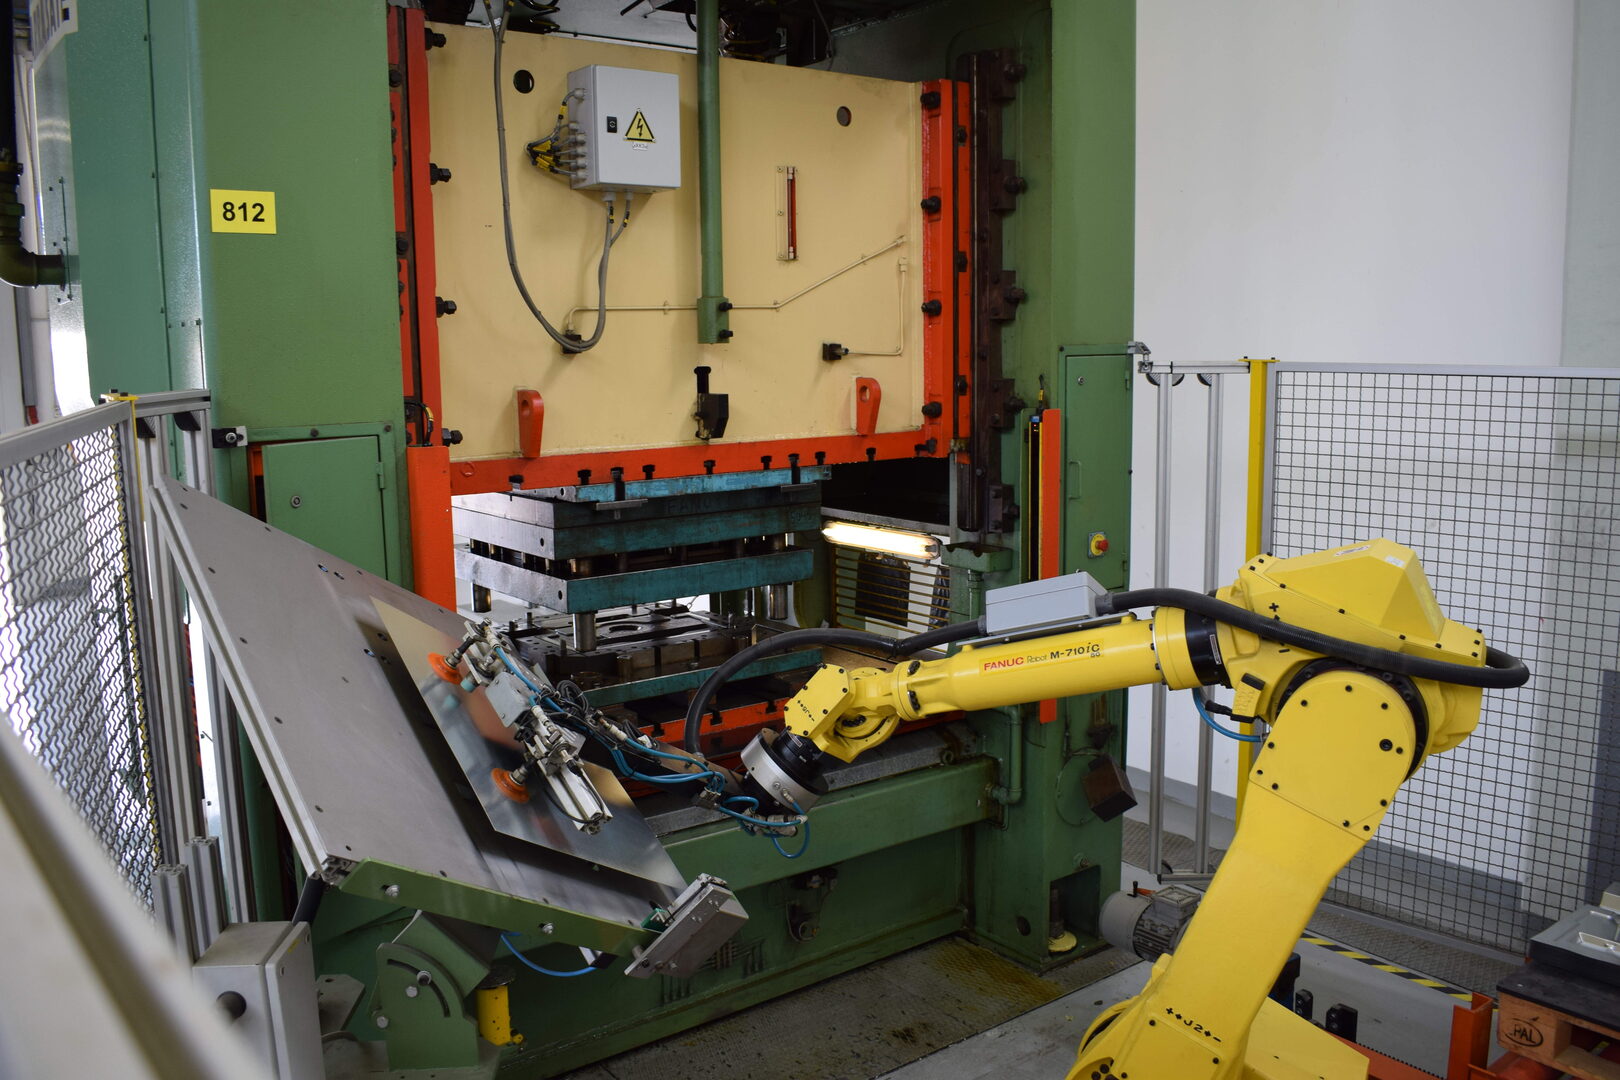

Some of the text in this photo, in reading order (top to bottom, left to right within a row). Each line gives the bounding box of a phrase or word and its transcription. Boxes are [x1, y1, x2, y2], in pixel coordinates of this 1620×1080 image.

[222, 201, 265, 222] 812
[983, 642, 1100, 671] FANUC Robot M-710iC
